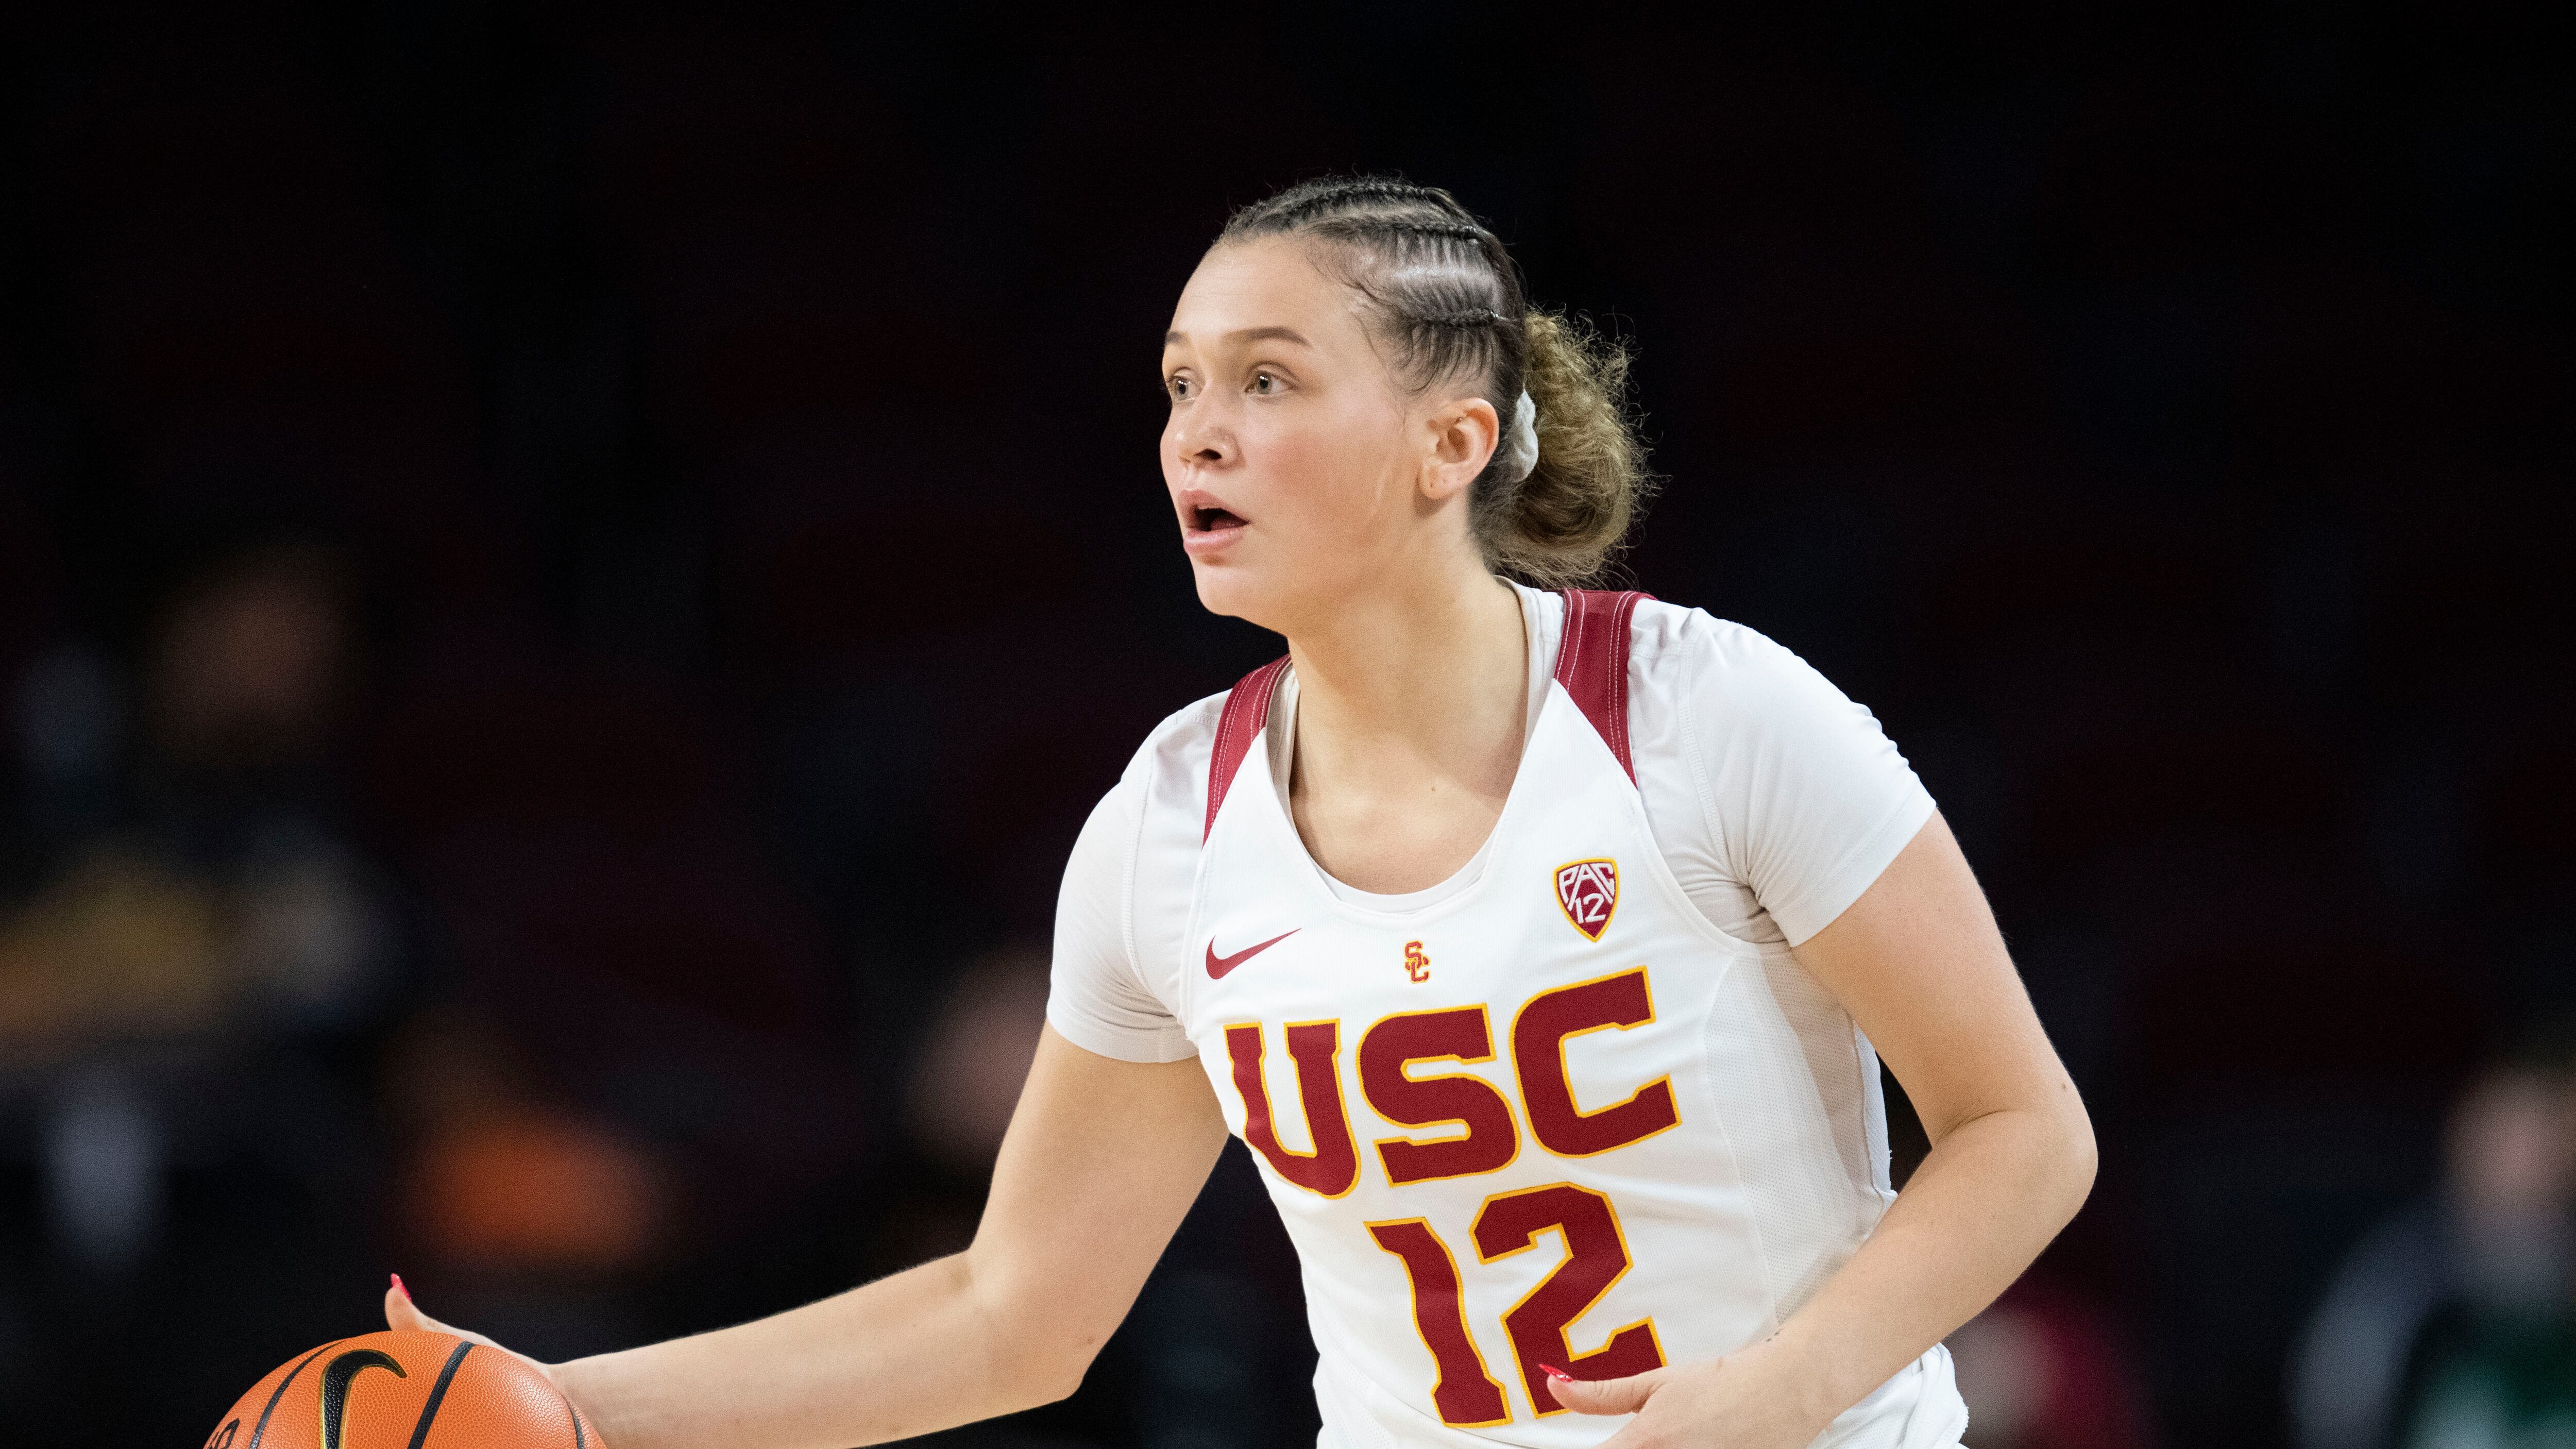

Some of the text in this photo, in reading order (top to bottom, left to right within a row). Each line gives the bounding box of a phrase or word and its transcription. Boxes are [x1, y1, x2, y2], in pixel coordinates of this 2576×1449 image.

[1558, 863, 1616, 911] PAC
[1574, 892, 1606, 924] 12
[1223, 965, 1682, 1199] USC
[1363, 1181, 1668, 1427] 12
